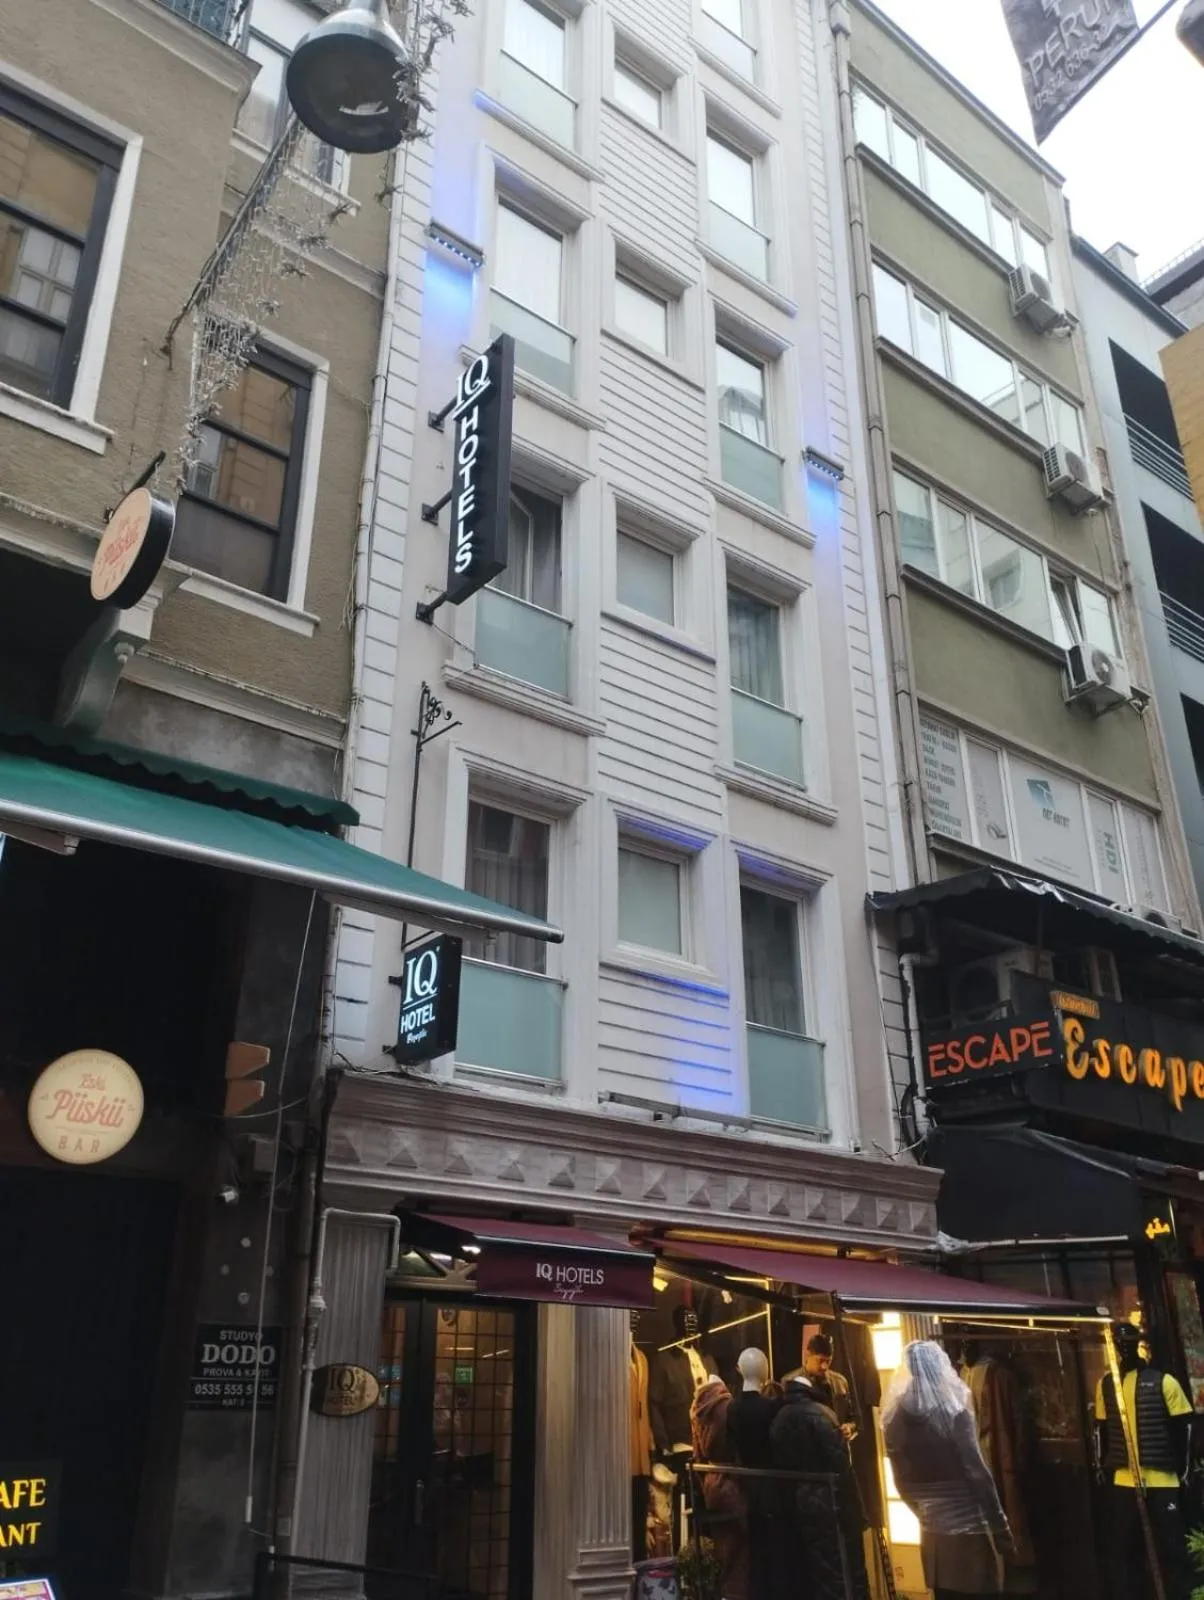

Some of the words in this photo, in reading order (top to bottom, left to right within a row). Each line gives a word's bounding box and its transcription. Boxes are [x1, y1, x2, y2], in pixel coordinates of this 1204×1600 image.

[455, 354, 491, 406] IQ
[454, 404, 480, 575] HOTELS
[402, 949, 438, 1005] IQ
[400, 1003, 436, 1034] HOTEL
[928, 1021, 1053, 1079] ESCAPE
[1062, 1016, 1204, 1112] Escape
[45, 1089, 124, 1129] Püskü
[58, 1135, 101, 1154] BAR
[536, 1262, 553, 1282] IQ
[556, 1265, 605, 1286] HOTELS
[200, 1343, 277, 1365] DODO
